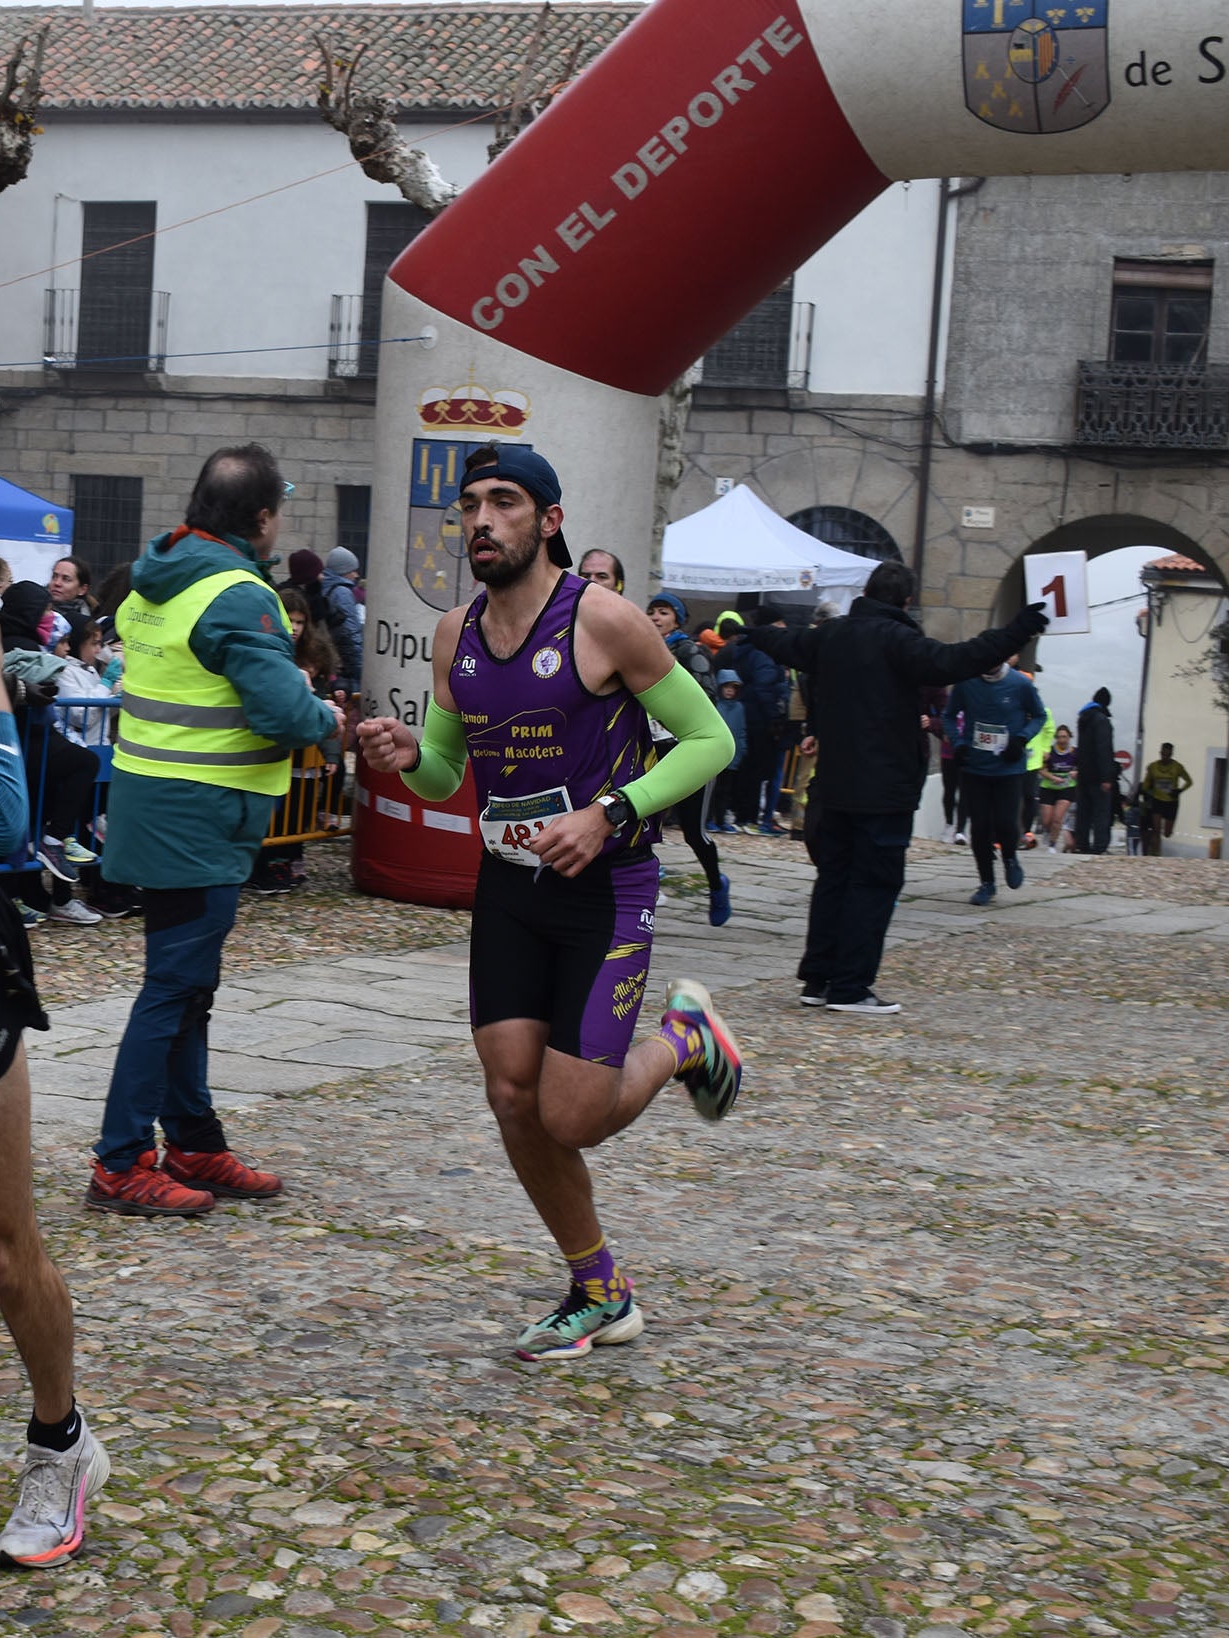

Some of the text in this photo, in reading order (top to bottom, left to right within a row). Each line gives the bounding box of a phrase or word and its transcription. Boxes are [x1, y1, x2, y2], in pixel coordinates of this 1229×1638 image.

[1124, 36, 1227, 87] de S
[471, 15, 804, 330] CON EL DEPORTE
[1041, 575, 1068, 618] 1
[375, 620, 432, 668] Dipu
[389, 687, 429, 727] Sal
[504, 745, 564, 759] Macotera
[511, 725, 553, 738] PRIM
[521, 796, 552, 807] NAVIDAD
